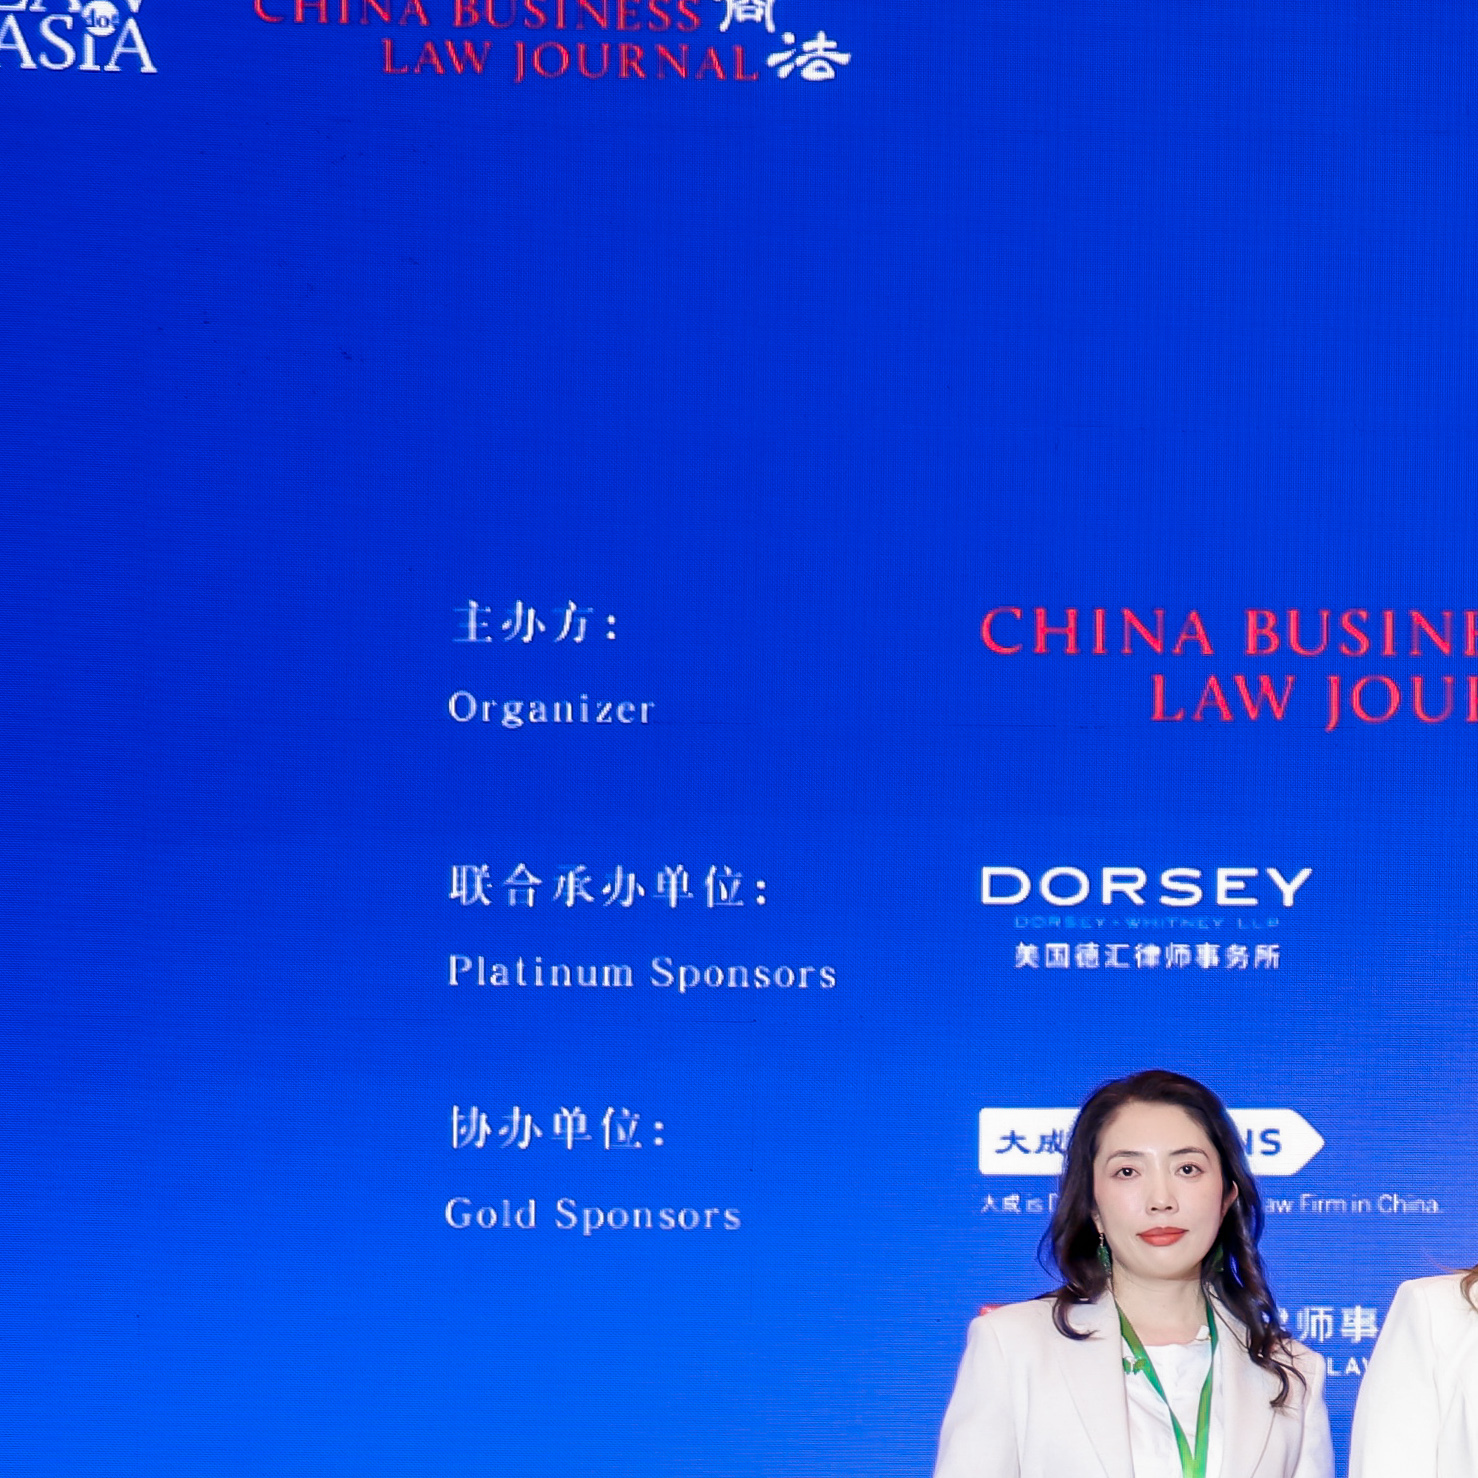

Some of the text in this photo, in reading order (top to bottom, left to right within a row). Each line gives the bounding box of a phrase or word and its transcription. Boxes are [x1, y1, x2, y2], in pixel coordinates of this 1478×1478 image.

[383, 39, 758, 82] LAW JOURNAL
[980, 607, 1214, 655] CHINA
[448, 690, 656, 729] Organizer
[1152, 673, 1296, 722] LAW
[980, 866, 1313, 907] DORSEY
[449, 955, 836, 994] Platinum Sponsors
[1015, 941, 1280, 970] 美国德汇律师事务所
[445, 1197, 741, 1236] Gold Sponsors
[1299, 1193, 1347, 1213] Firm
